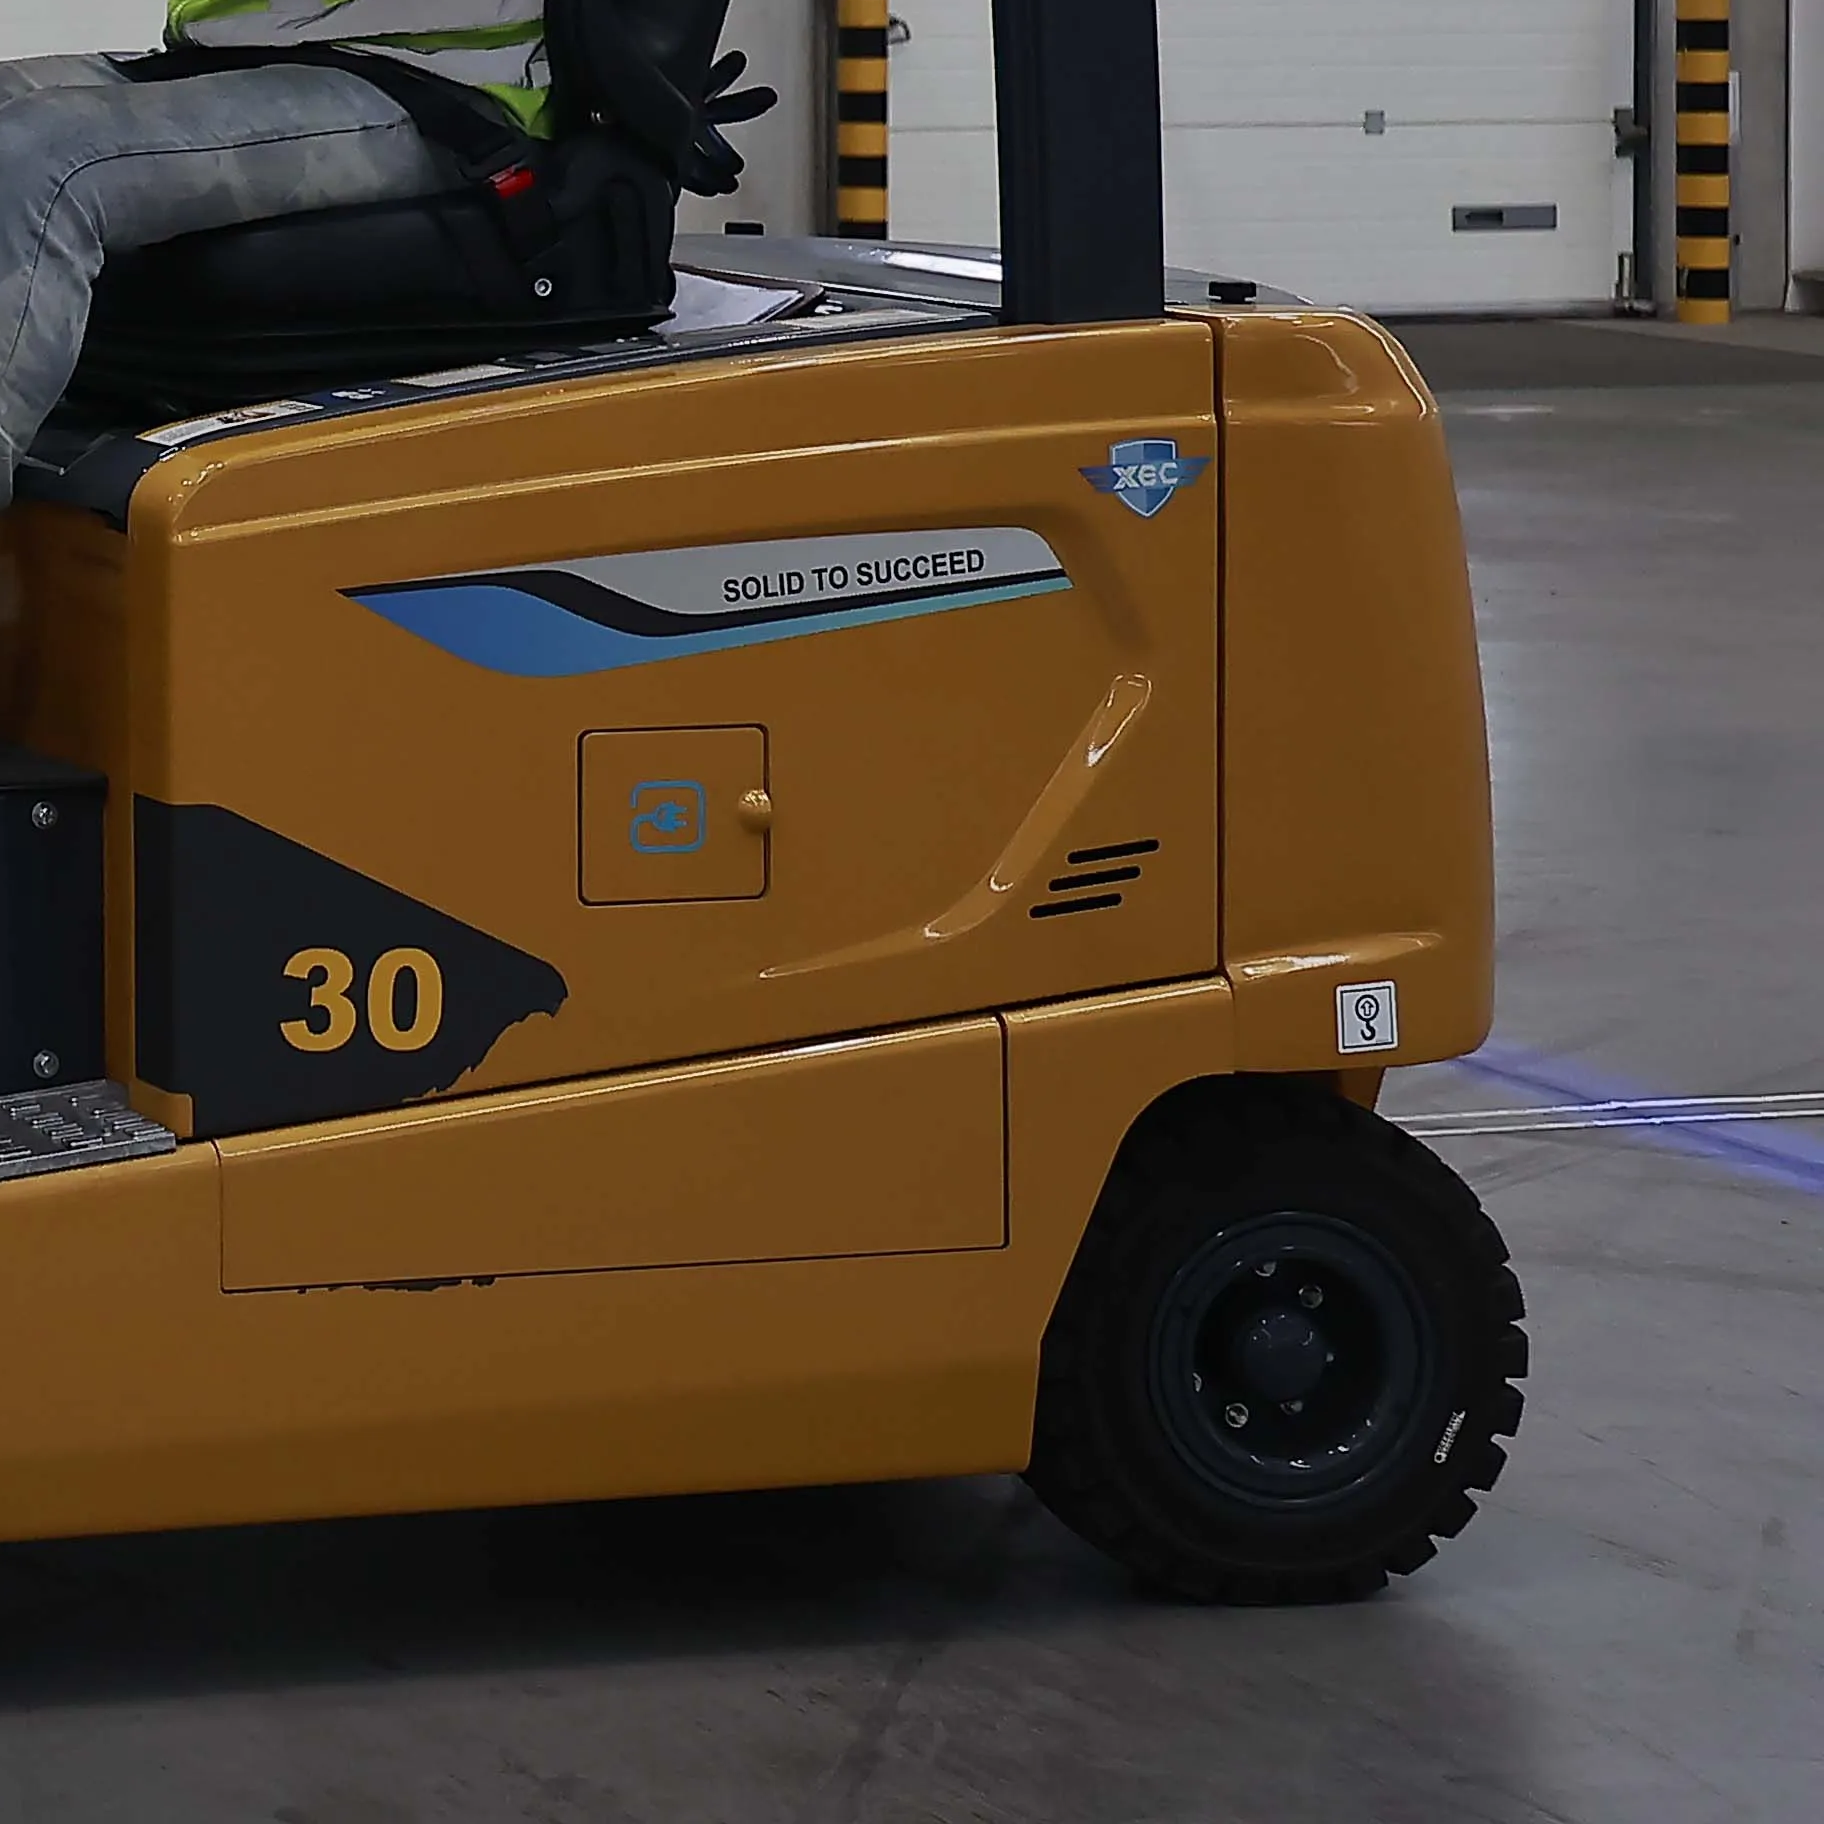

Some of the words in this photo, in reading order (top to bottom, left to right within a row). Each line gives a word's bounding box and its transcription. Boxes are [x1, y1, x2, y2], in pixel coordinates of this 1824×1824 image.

[723, 570, 804, 604] SOLID
[811, 566, 849, 593] TO
[855, 547, 986, 587] SUCCEED
[280, 947, 443, 1051] 30
